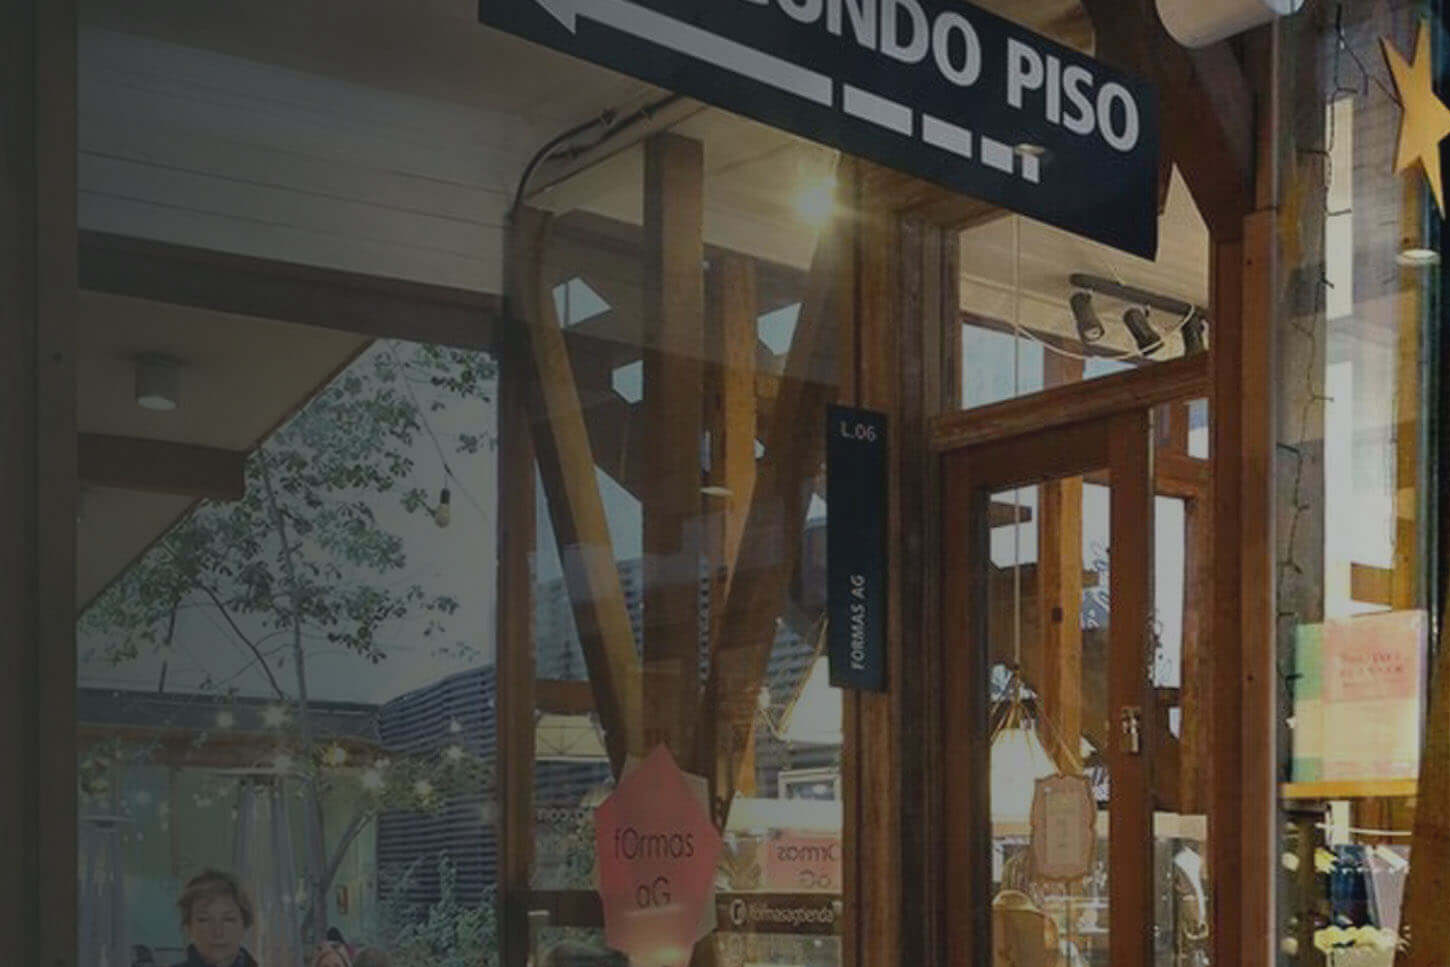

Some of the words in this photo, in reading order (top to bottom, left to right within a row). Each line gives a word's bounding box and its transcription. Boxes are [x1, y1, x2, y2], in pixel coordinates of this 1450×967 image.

[1007, 37, 1140, 153] PISO
[840, 421, 876, 442] L.06
[850, 573, 866, 599] AG
[850, 602, 866, 670] FORMAS
